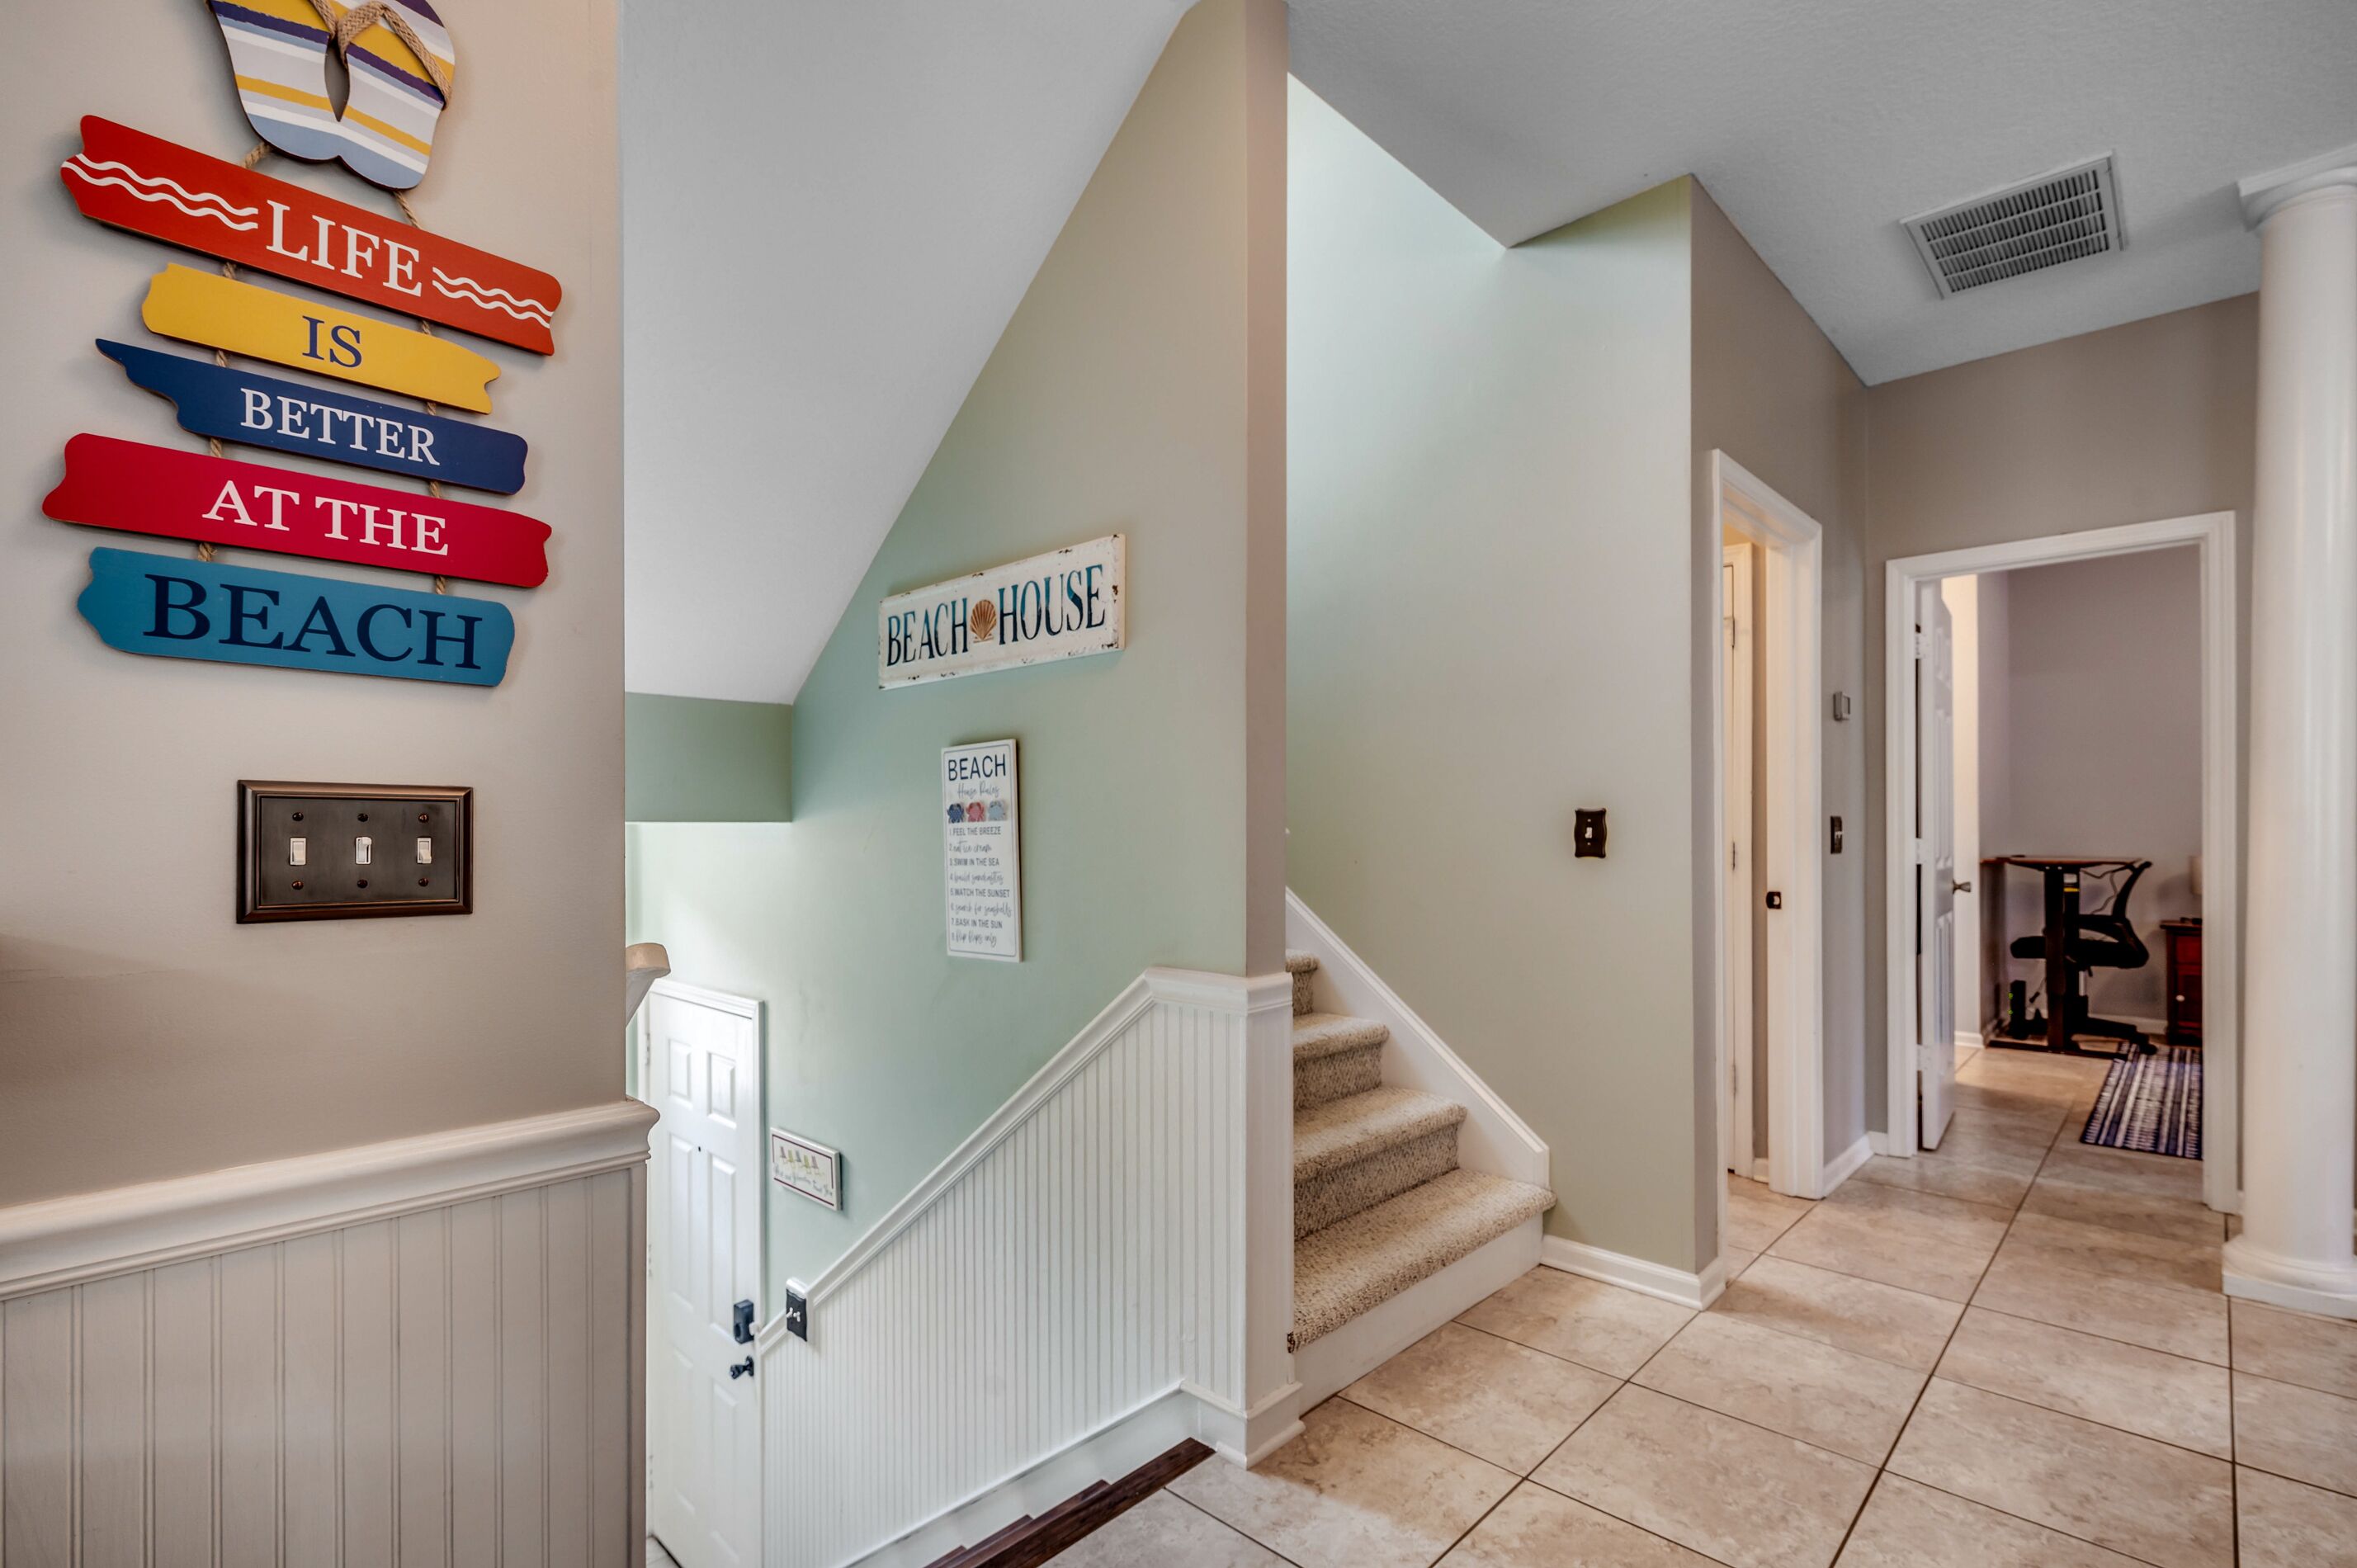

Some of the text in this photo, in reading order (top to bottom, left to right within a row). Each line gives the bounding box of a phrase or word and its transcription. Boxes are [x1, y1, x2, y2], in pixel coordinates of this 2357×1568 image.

[266, 199, 423, 298] LIFE
[302, 315, 362, 368] IS
[240, 387, 440, 466] BETTER
[201, 480, 448, 556] AT THE
[143, 574, 482, 670] BEACH
[886, 564, 1107, 667] BEACH HOUSE
[948, 753, 1006, 781] BEACH
[967, 826, 978, 836] THE
[980, 825, 1001, 835] BREEZE
[969, 857, 975, 866] IN
[976, 857, 987, 867] THE
[989, 857, 999, 867] SEA
[975, 888, 986, 897] THE
[987, 889, 1009, 898] SUNSET
[978, 919, 990, 928] THE
[990, 919, 1003, 929] SUN
